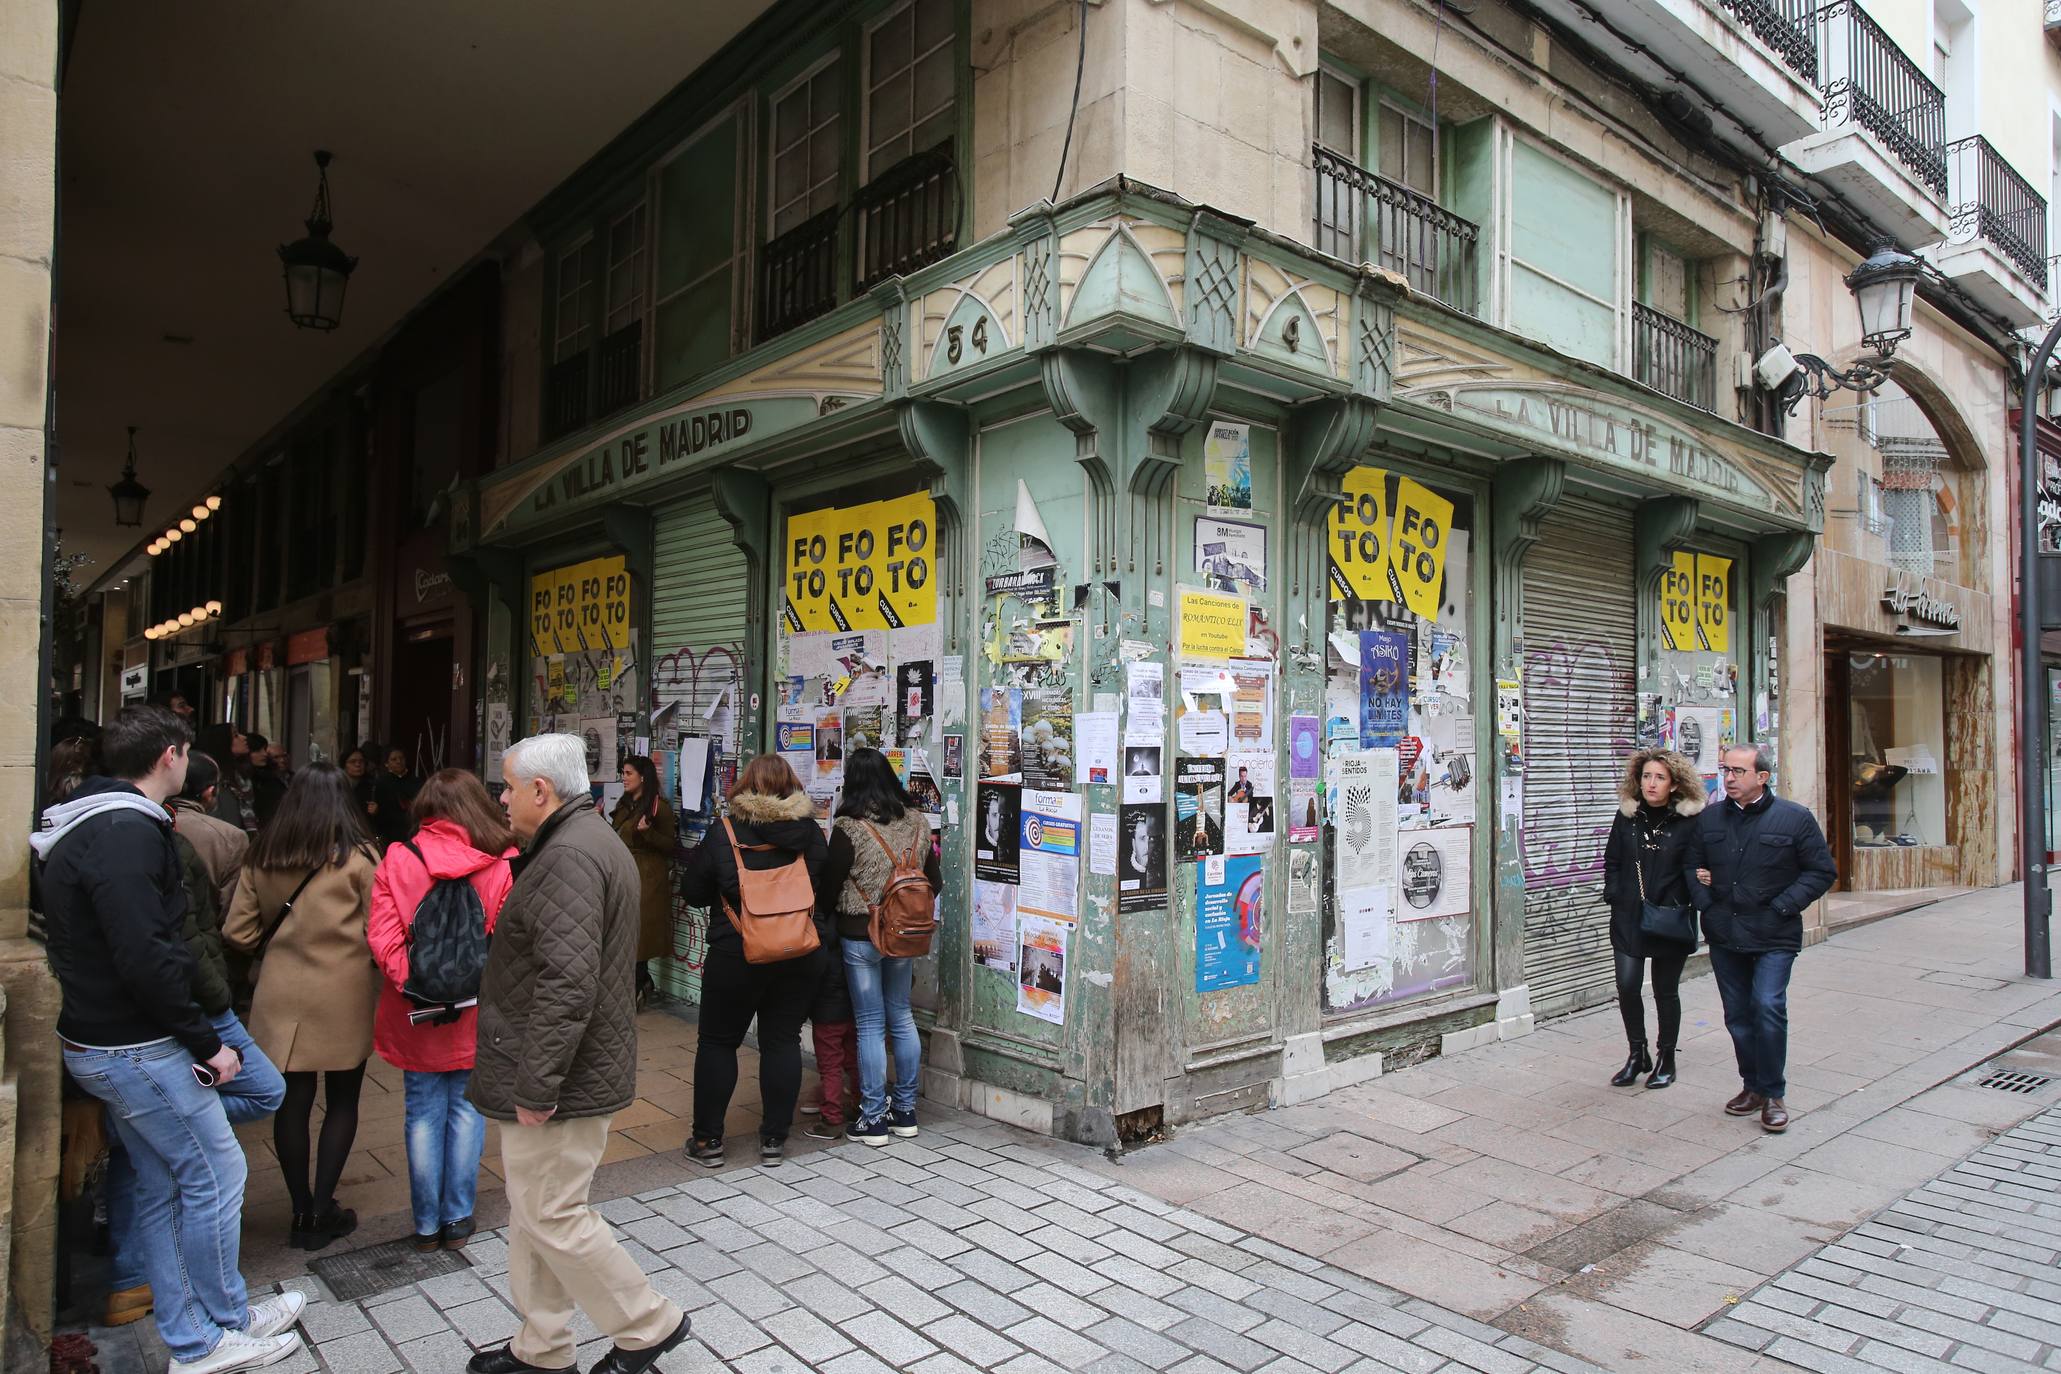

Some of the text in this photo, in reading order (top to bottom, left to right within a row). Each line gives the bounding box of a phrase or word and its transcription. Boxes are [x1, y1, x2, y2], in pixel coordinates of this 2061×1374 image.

[947, 315, 988, 365] 54
[1496, 398, 1740, 494] LA VILLA DE MADRID
[534, 408, 753, 512] LA VILLA DE MADRID
[1337, 491, 1378, 526] FO
[887, 519, 928, 557] FO
[1216, 527, 1229, 537] 8M
[1402, 504, 1439, 549] FO
[793, 534, 826, 567] FO
[838, 529, 874, 564] FO
[1337, 530, 1380, 564] TO
[1399, 538, 1435, 583] TO
[606, 574, 626, 599] FO
[793, 568, 826, 600] TO
[837, 565, 874, 598] TO
[887, 556, 928, 593] TO
[1330, 566, 1353, 598] CURSOS
[1387, 568, 1404, 604] CURSOS
[1667, 570, 1689, 596] FO
[1702, 574, 1723, 599] FO
[535, 589, 551, 612] FO
[558, 583, 575, 607] FO
[582, 577, 600, 602] FO
[1199, 598, 1231, 608] Canciones
[535, 612, 551, 635] TO
[557, 608, 574, 631] TO
[581, 602, 599, 627] TO
[606, 600, 625, 625] TO
[785, 604, 801, 631] CURSOS
[829, 603, 846, 631] CURSOS
[879, 599, 898, 627] CURSOS
[1667, 598, 1690, 624] TO
[1702, 601, 1723, 626] TO
[1023, 690, 1040, 700] XVIII
[1368, 697, 1402, 708] NO HAY
[1229, 755, 1274, 770] Concierto
